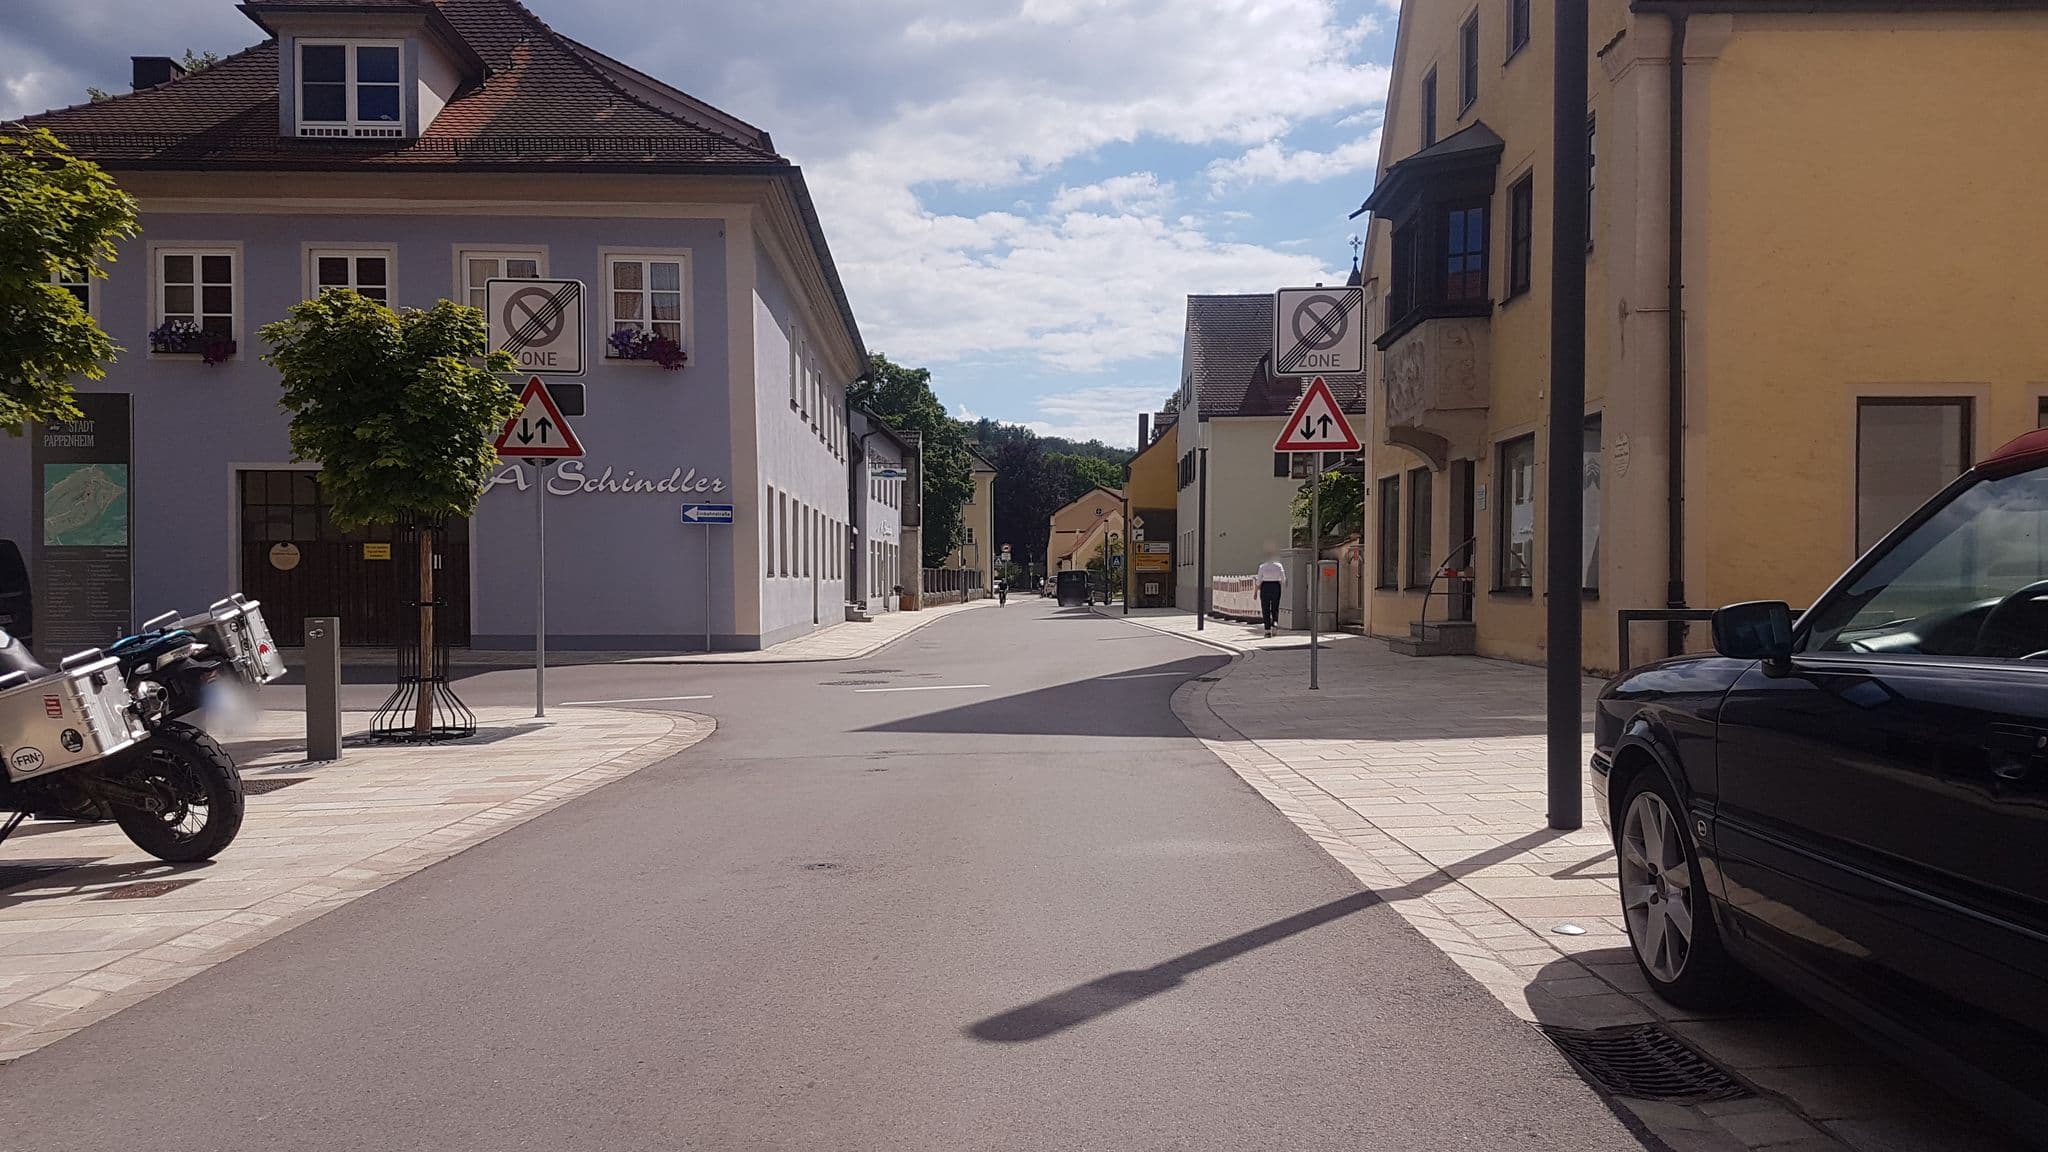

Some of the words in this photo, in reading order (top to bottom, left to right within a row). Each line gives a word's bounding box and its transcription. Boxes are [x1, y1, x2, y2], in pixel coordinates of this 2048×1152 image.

[515, 351, 557, 366] ONE
[1298, 353, 1341, 368] ZONE
[68, 420, 95, 433] STADT
[44, 434, 95, 447] PAPPENHEIM
[546, 459, 727, 496] Schindler
[16, 752, 39, 767] FRN
